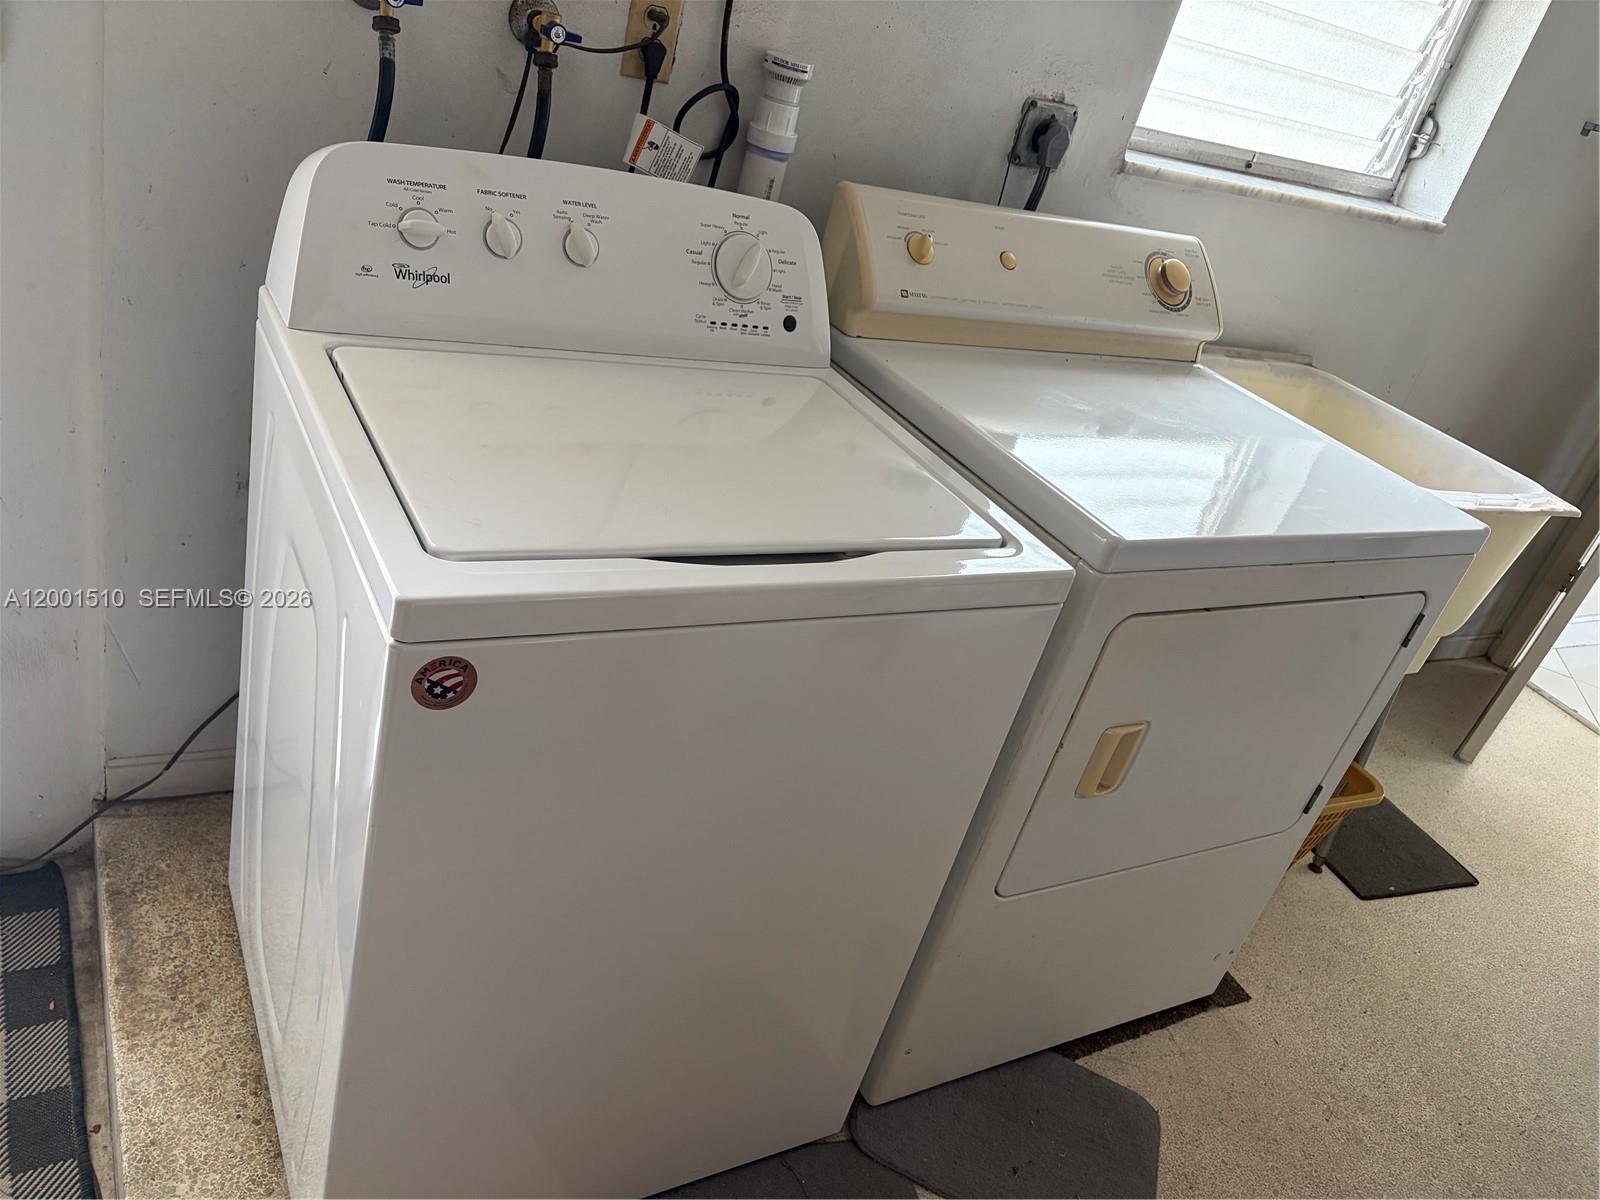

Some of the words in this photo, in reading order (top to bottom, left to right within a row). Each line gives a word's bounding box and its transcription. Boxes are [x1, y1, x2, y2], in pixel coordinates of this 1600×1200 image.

[386, 178, 405, 186] WASH
[406, 180, 447, 190] TEMPERATURE
[476, 189, 498, 197] FABRIC
[498, 192, 527, 200] SOFTENER
[685, 248, 703, 256] Casual
[777, 258, 797, 266] Delicate
[393, 267, 451, 286] Whirlpool
[415, 659, 469, 686] AMERICA
